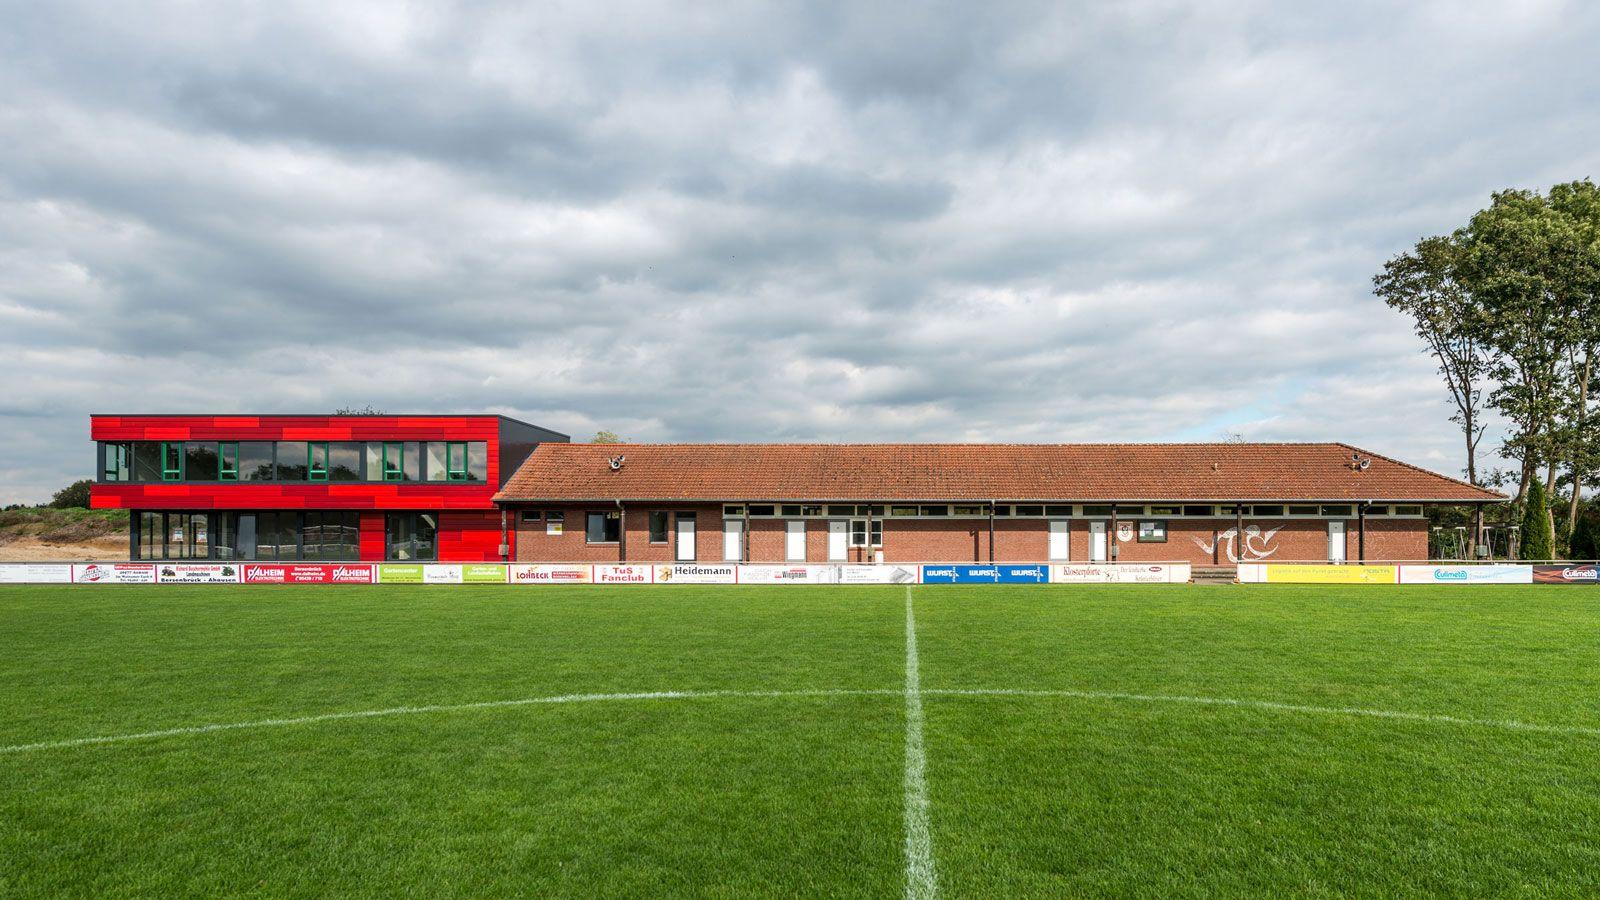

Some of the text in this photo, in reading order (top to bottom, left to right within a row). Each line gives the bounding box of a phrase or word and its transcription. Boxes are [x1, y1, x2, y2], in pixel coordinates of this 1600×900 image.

[674, 566, 731, 575] Heidemann
[1435, 569, 1467, 580] Culimeta
[1563, 568, 1597, 579] Culimeta
